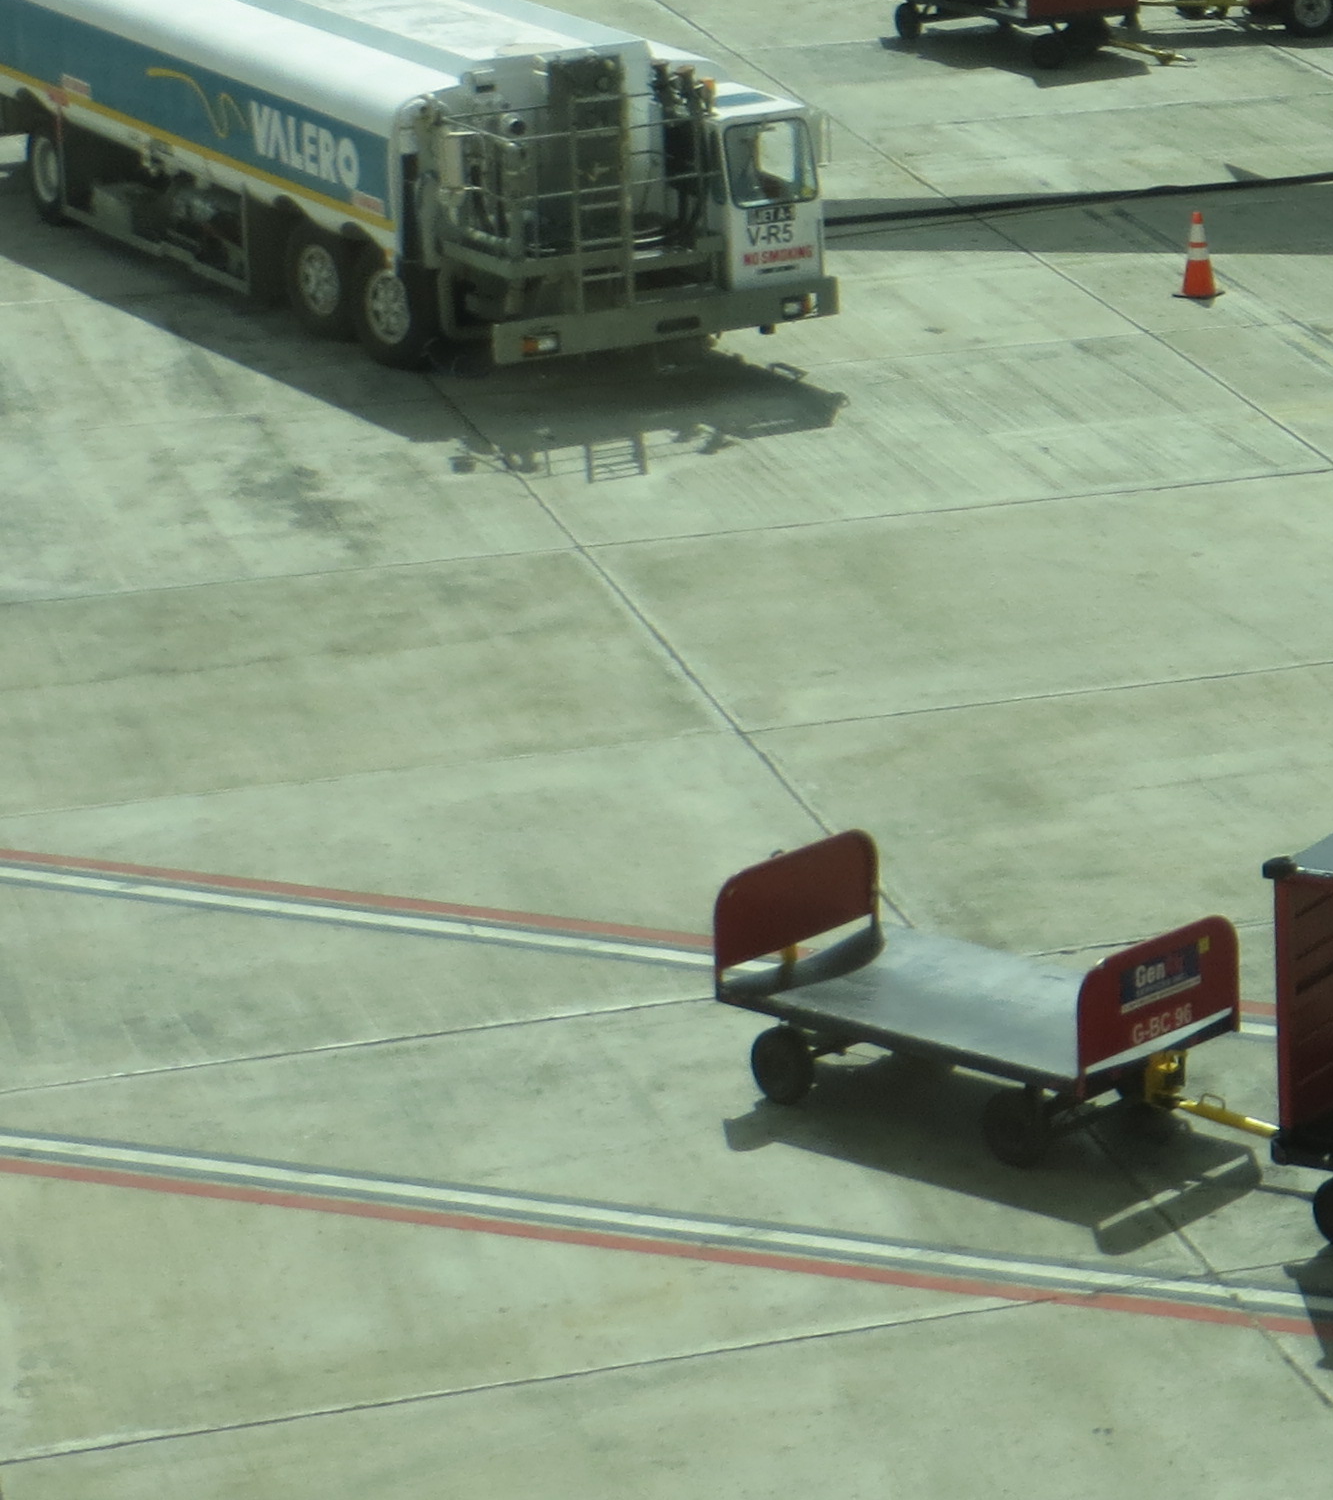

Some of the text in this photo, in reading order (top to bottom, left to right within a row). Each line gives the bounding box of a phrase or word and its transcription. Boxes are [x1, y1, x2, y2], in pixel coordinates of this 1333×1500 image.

[250, 100, 360, 190] VALERO
[747, 224, 793, 246] V-R5
[744, 245, 814, 266] NO SMOKING
[1132, 1011, 1171, 1044] G-BC
